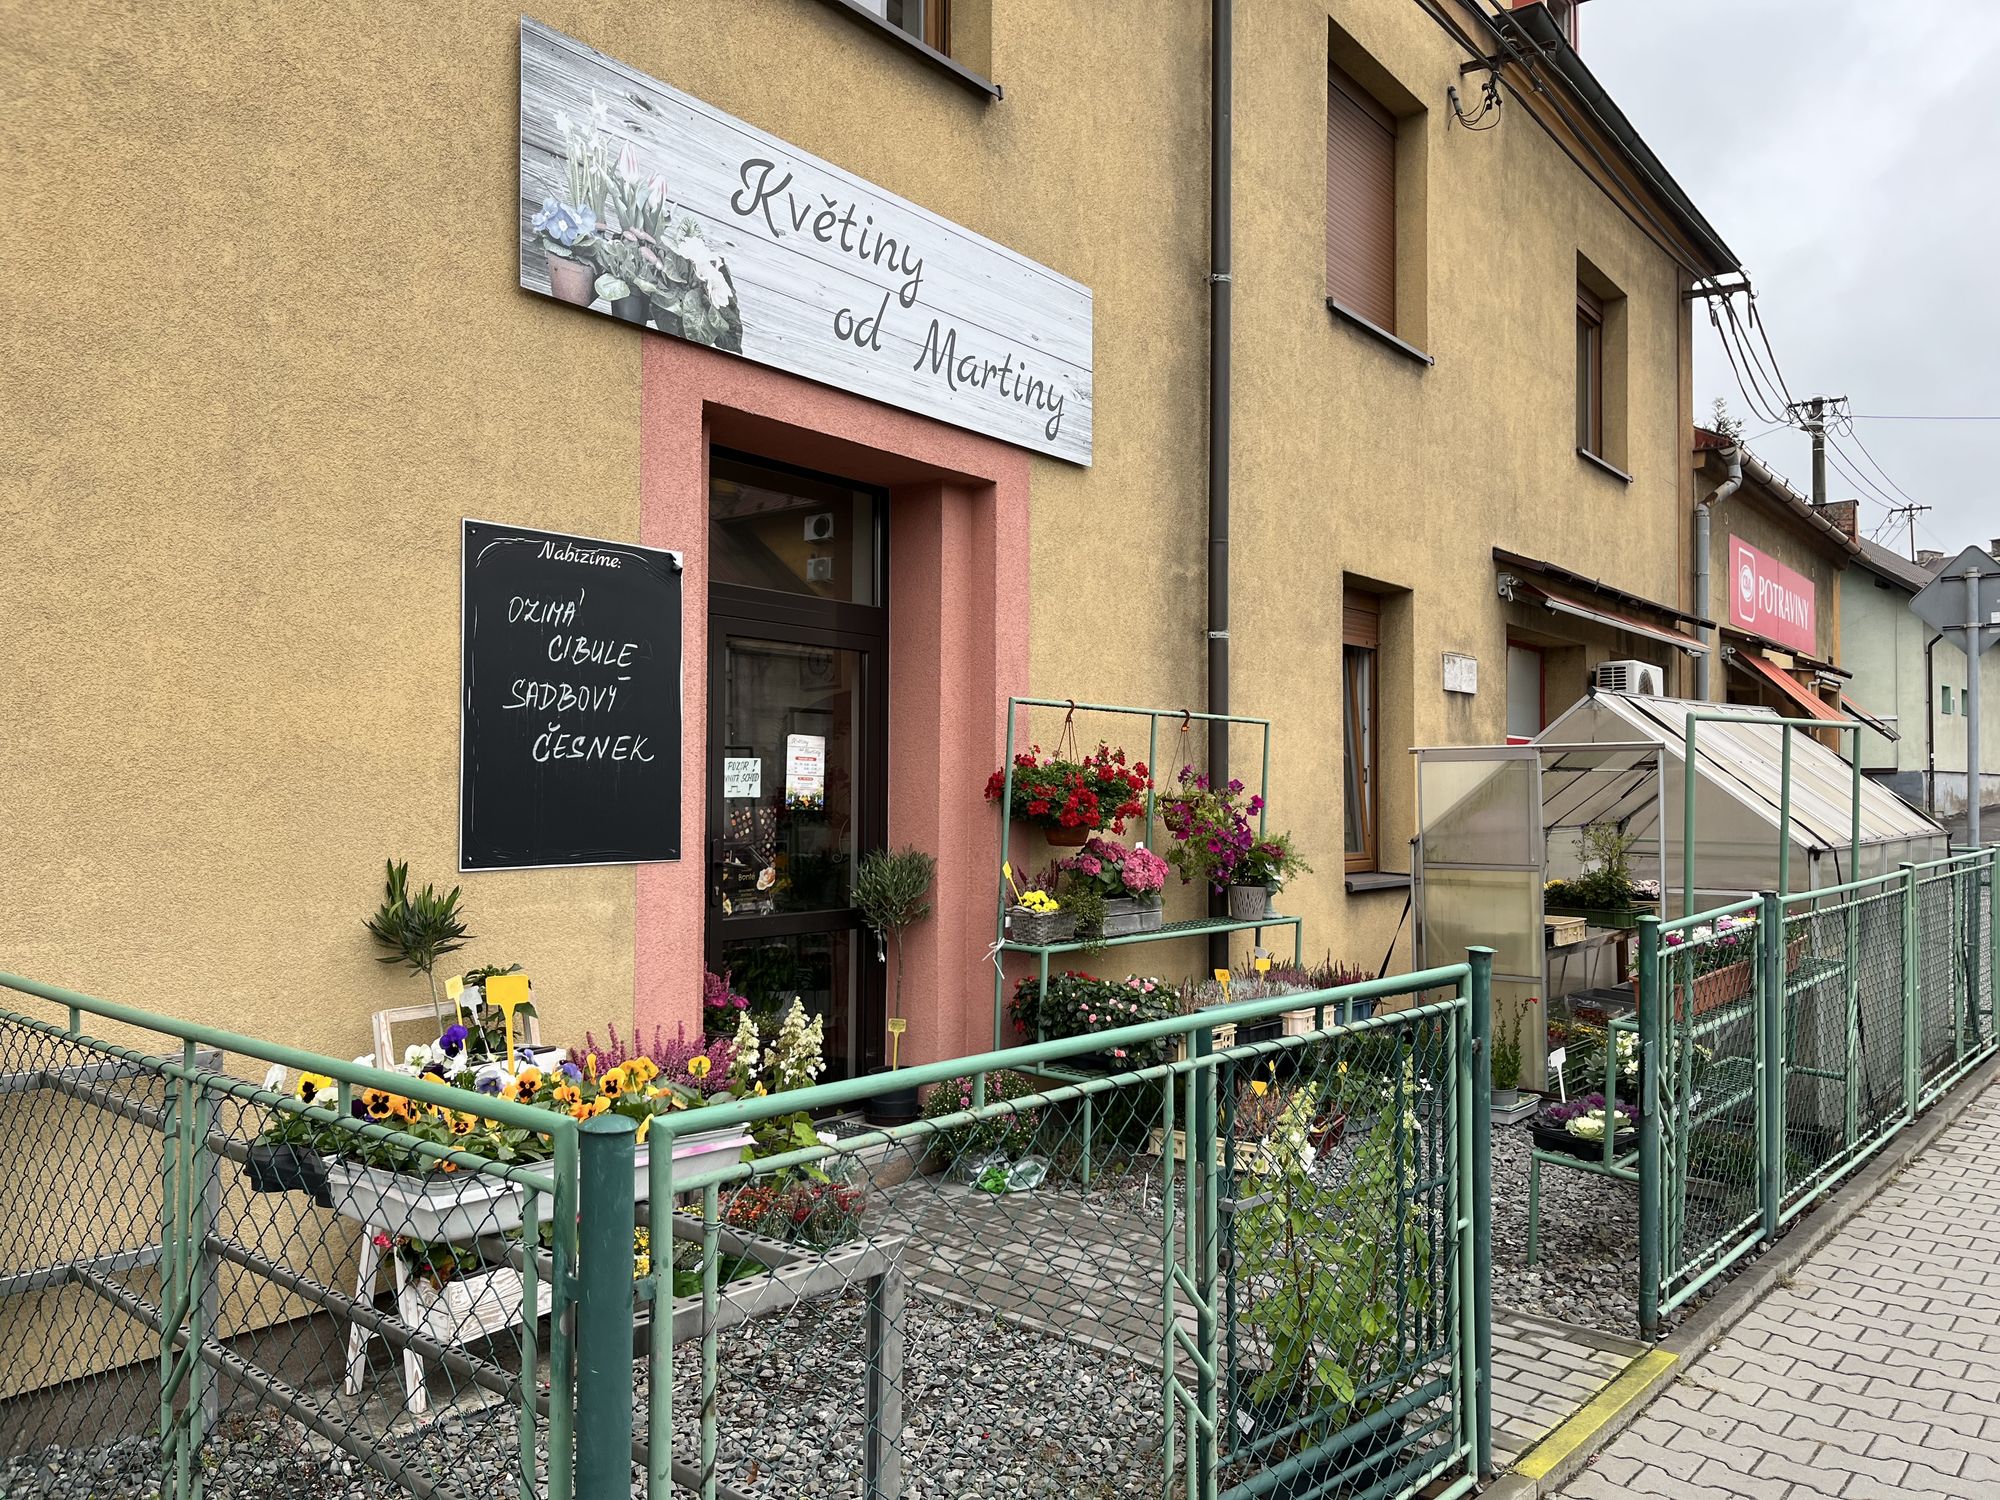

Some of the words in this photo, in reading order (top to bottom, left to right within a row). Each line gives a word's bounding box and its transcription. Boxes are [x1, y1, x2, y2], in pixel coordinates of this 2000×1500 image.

[731, 158, 924, 309] Květiny
[834, 292, 890, 352] od
[913, 319, 1065, 442] Martiny
[508, 587, 585, 628] OZIMÁ
[1759, 575, 1809, 630] POTRAVINY
[548, 634, 639, 668] CIBULE
[532, 721, 655, 763] ČESNEK
